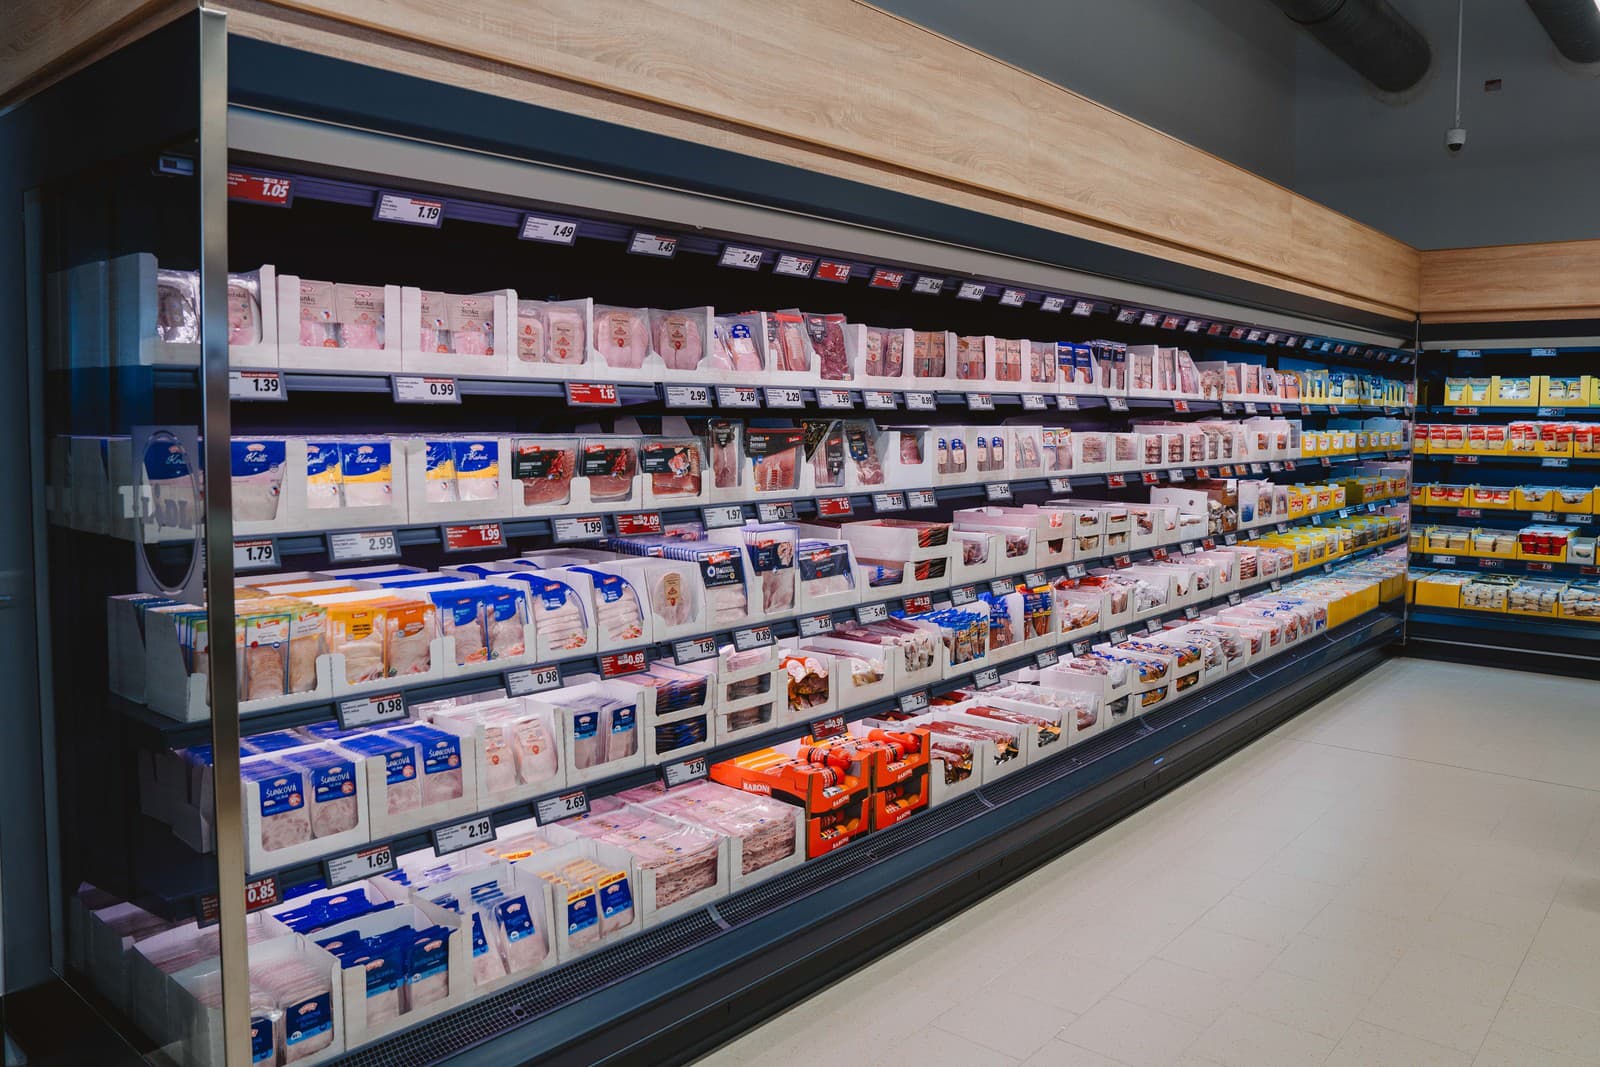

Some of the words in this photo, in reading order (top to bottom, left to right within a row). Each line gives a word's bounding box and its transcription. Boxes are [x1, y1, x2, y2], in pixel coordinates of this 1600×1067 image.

[262, 183, 290, 198] 1.05
[417, 207, 439, 220] 1.19
[552, 224, 574, 238] 1.49
[743, 253, 760, 265] 2.49
[796, 261, 812, 273] 3.49
[253, 378, 278, 392] 1.39
[430, 384, 454, 396] 0.99
[690, 390, 706, 401] 2.99
[740, 393, 755, 403] 2.49
[786, 392, 800, 403] 2.29
[643, 515, 659, 526] 2.09
[726, 509, 741, 521] 1.97
[584, 521, 602, 534] 1.99
[480, 529, 500, 541] 1.99
[369, 537, 393, 551] 2.99
[246, 547, 273, 561] 1.79
[819, 617, 832, 627] 2.87
[756, 631, 771, 642] 0.89
[700, 641, 715, 655] 1.99
[628, 653, 645, 665] 0.69
[537, 670, 557, 685] 0.98
[377, 698, 402, 714] 0.98
[690, 760, 705, 775] 2.97
[743, 781, 770, 794] BARONI
[566, 795, 585, 811] 2.69
[469, 820, 490, 838] 2.19
[367, 851, 390, 869] 1.69
[247, 883, 275, 903] 0.85
